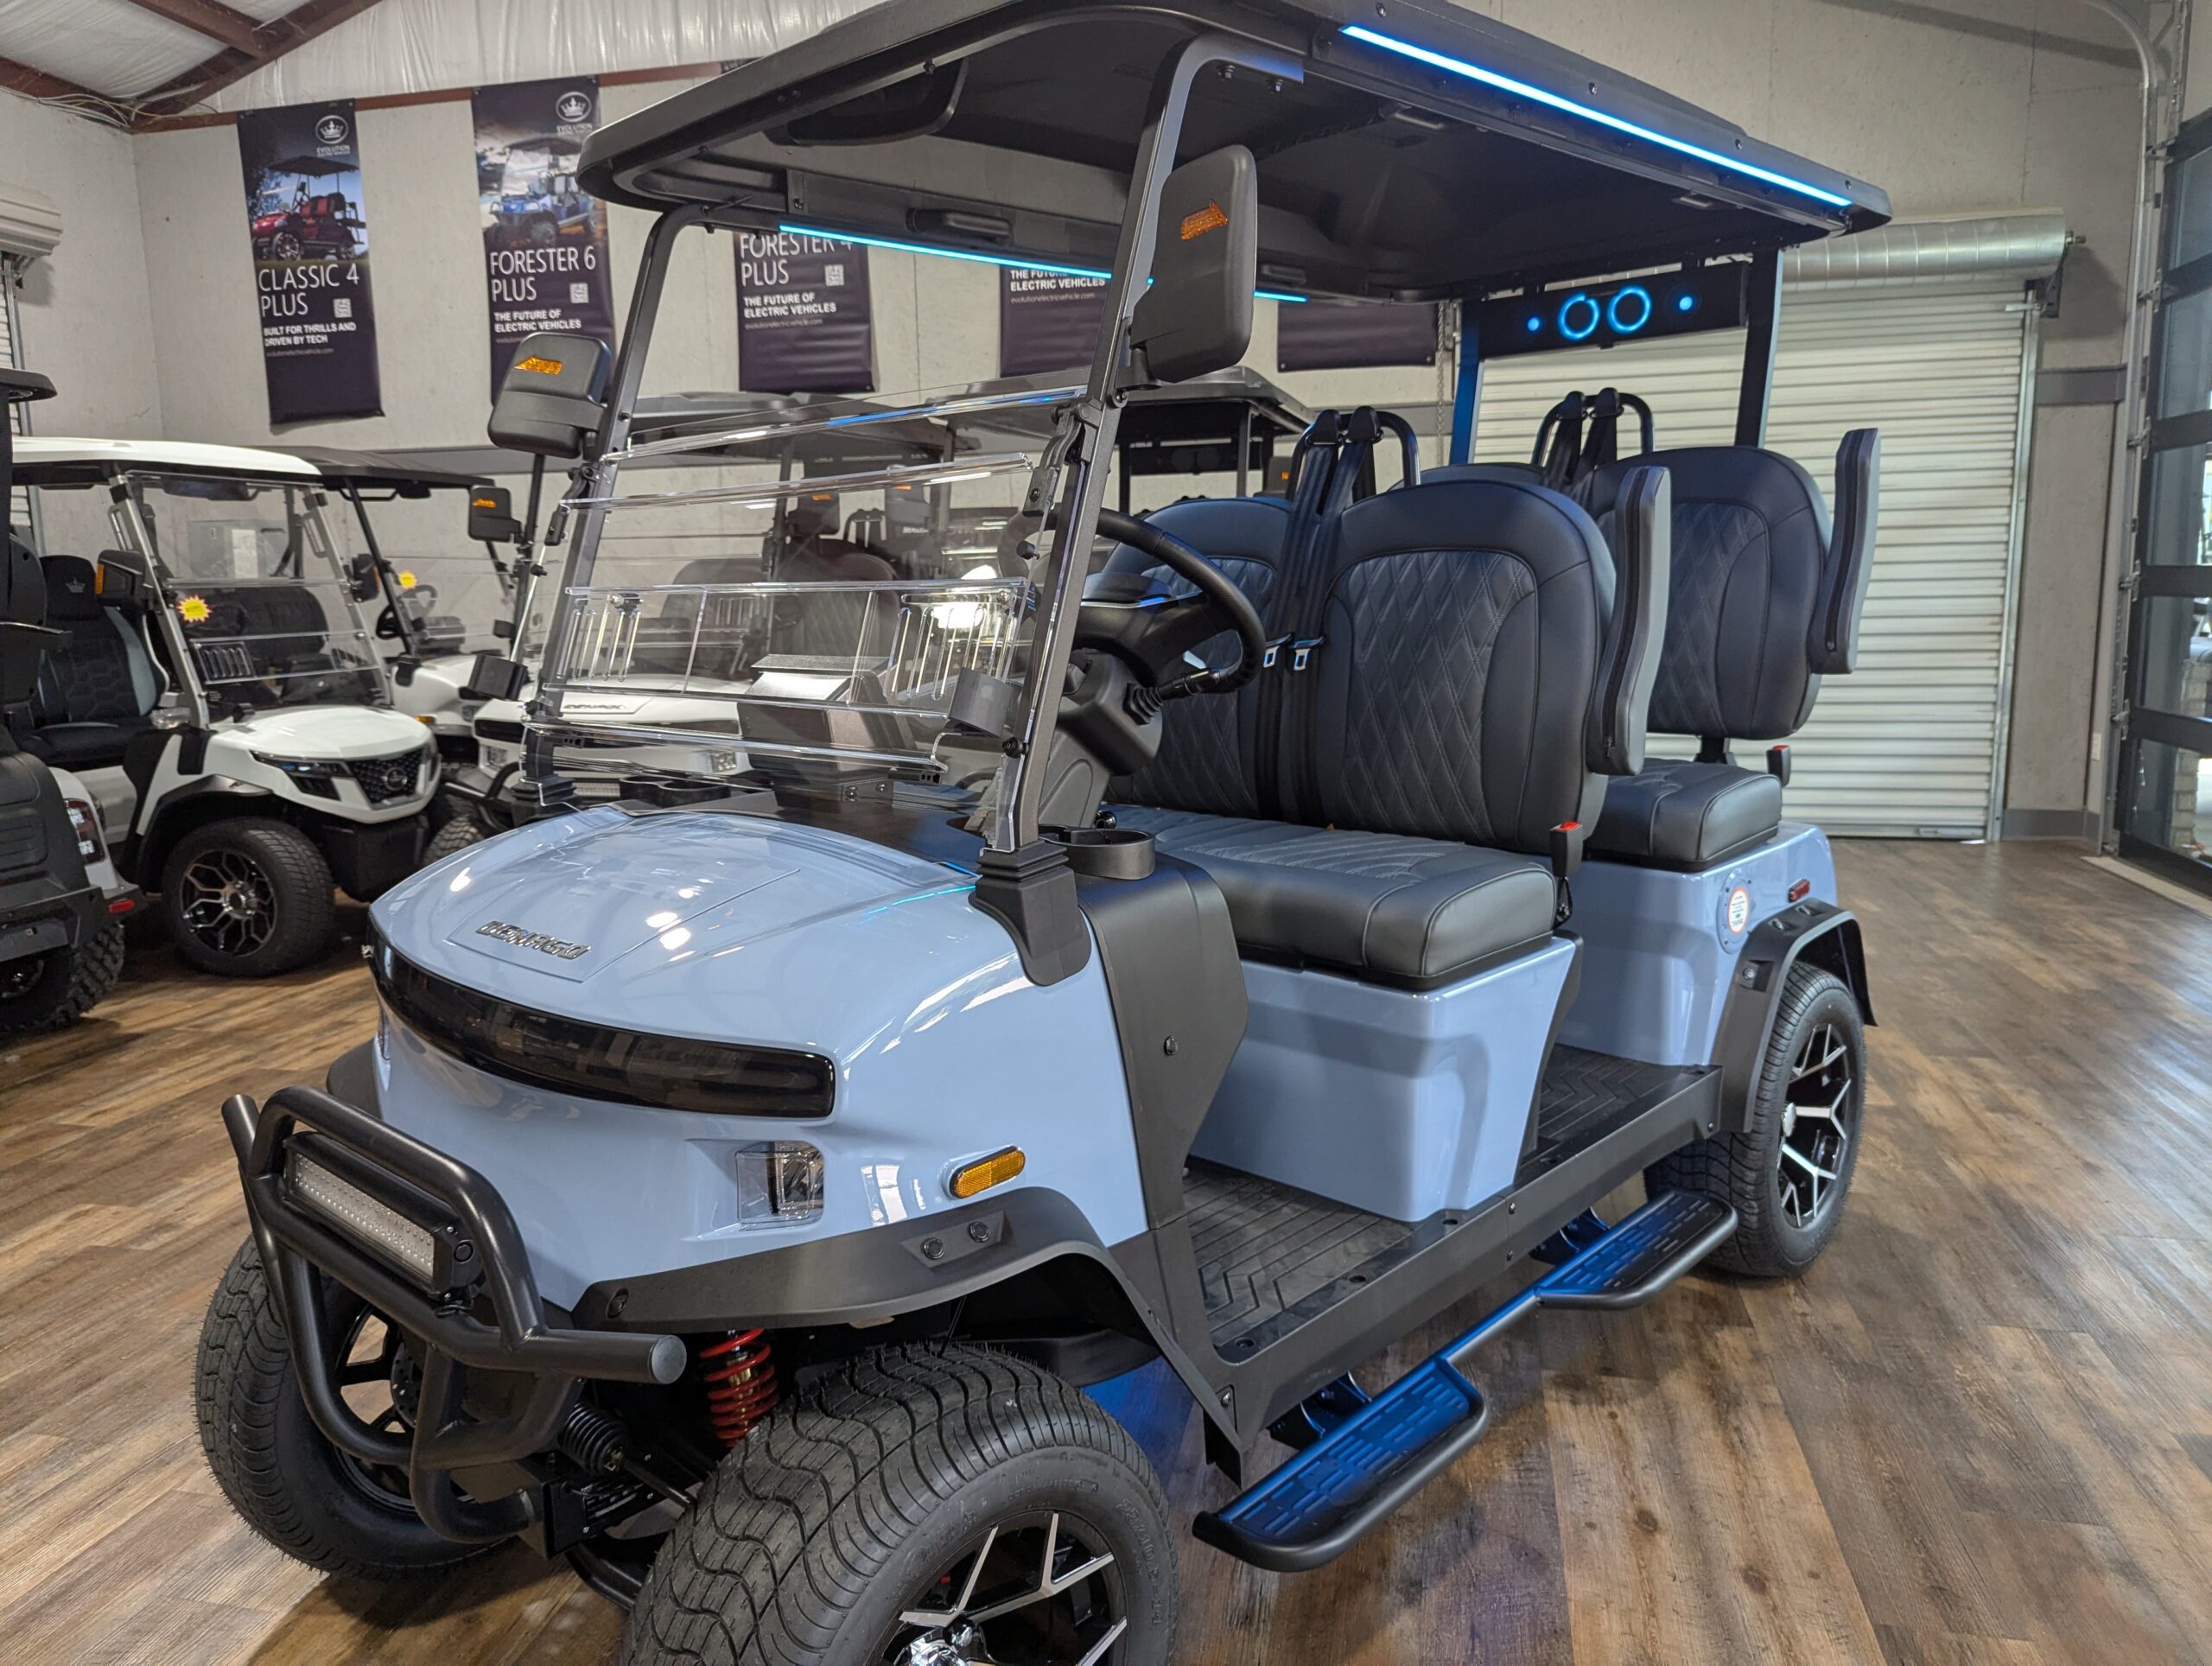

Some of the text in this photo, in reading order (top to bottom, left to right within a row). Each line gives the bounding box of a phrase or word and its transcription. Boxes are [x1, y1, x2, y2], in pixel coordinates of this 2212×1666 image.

[740, 232, 835, 259] FORESTER
[489, 245, 596, 276] FORESTER 6
[258, 263, 359, 291] CLASSIC 4
[741, 258, 790, 287] PLUS
[1010, 270, 1028, 279] THE
[491, 277, 537, 302] PLUS
[1010, 277, 1106, 292] ELECTRIC VEHICLES
[261, 292, 308, 317] PLUS
[743, 291, 816, 307] THE FUTURE OF
[493, 308, 562, 321] THE FUTURE OF
[744, 302, 836, 318] ELECTRIC VEHICLES
[264, 321, 357, 336] BUILT FOR THRILLS AND
[494, 318, 582, 333] ELECTRIC VEHICLES
[264, 334, 328, 347] DRIVEN BY TECH
[474, 920, 593, 960] DENAGO
